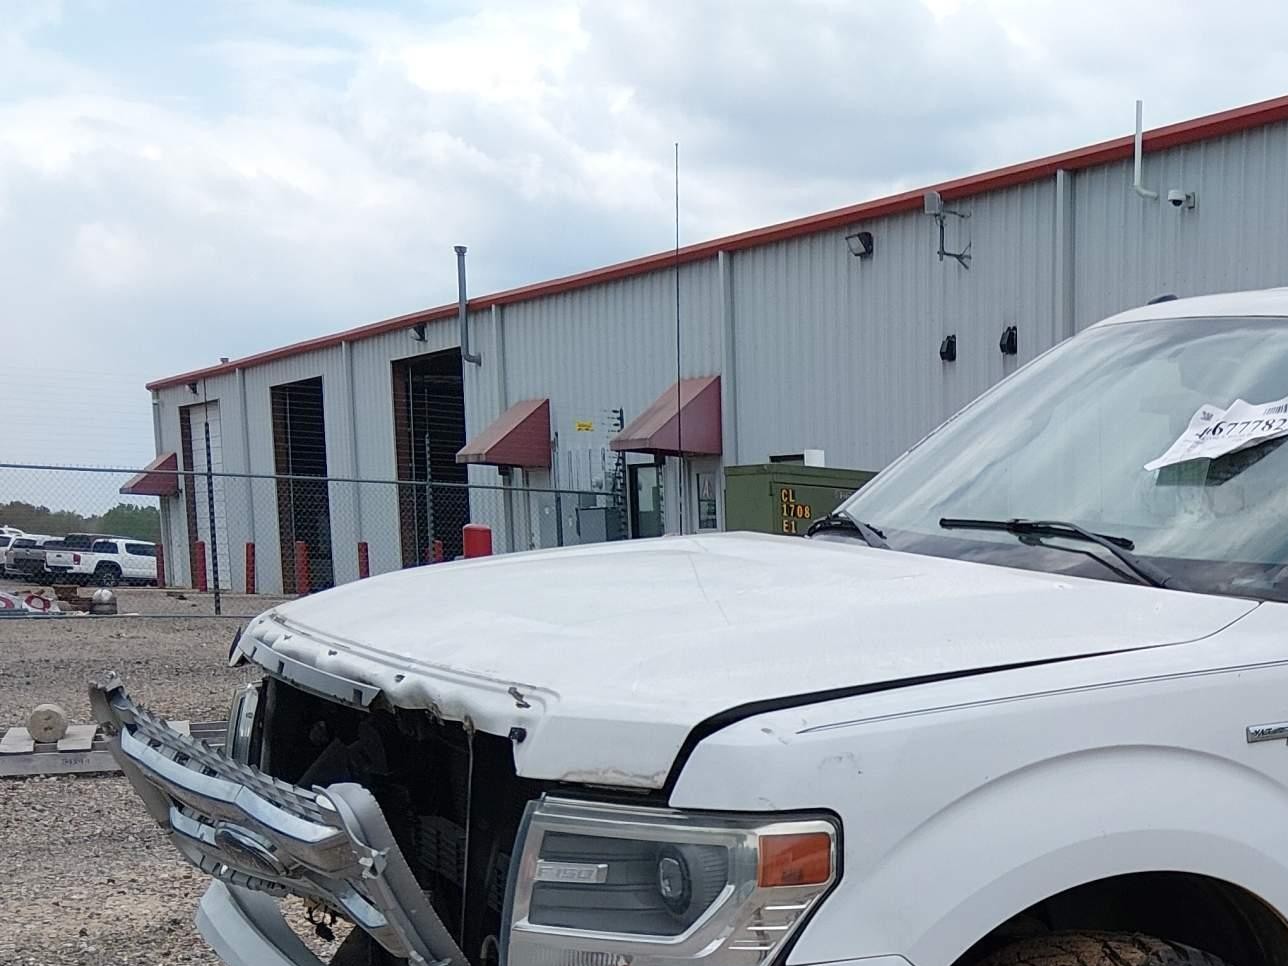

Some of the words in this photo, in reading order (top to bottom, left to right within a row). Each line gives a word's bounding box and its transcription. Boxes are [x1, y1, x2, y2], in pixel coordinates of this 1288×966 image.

[781, 488, 796, 503] CL
[782, 503, 811, 519] 1708
[783, 519, 797, 533] E1
